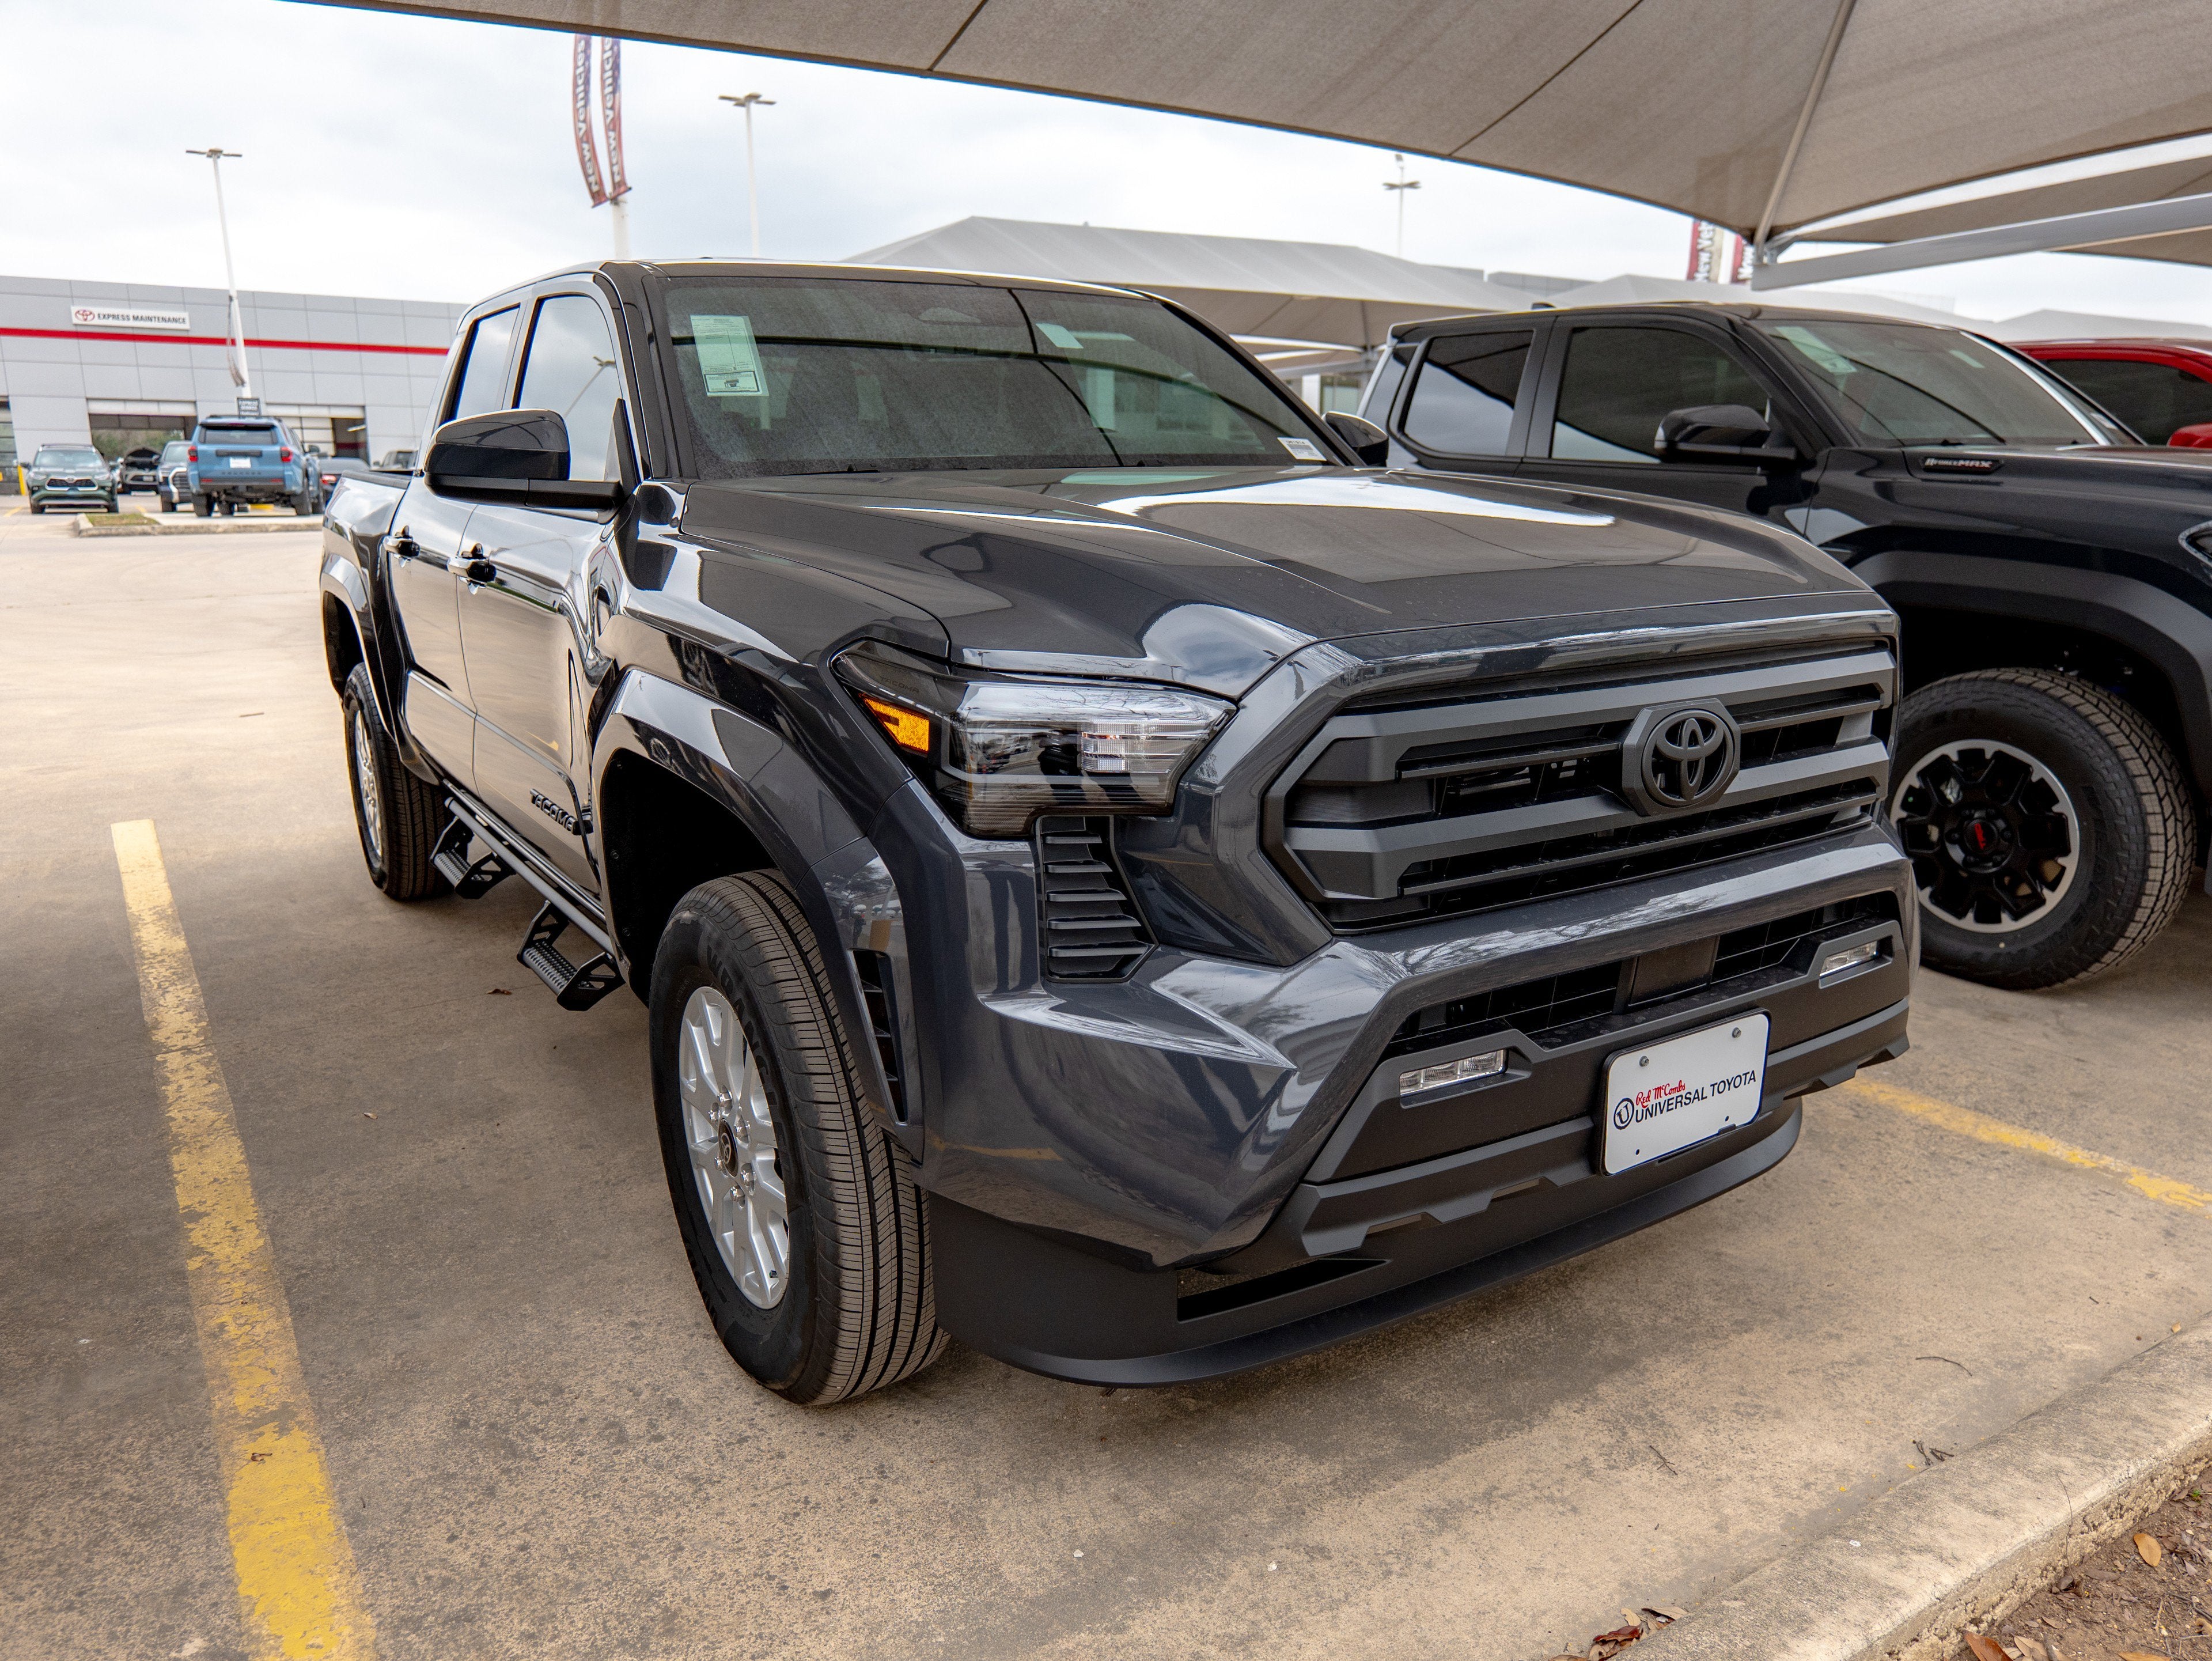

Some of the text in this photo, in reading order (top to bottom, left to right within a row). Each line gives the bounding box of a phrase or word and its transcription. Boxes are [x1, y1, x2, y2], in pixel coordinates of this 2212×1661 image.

[575, 39, 601, 193] New Vehicles
[607, 131, 622, 183] New
[97, 313, 187, 324] EXPRESS MAINTENANCE
[878, 675, 920, 694] TACOMA
[529, 788, 578, 835] TACOMA
[1635, 1080, 1685, 1108] Red McCombs
[1635, 1070, 1756, 1123] UNIVERSAL TOYOTA
